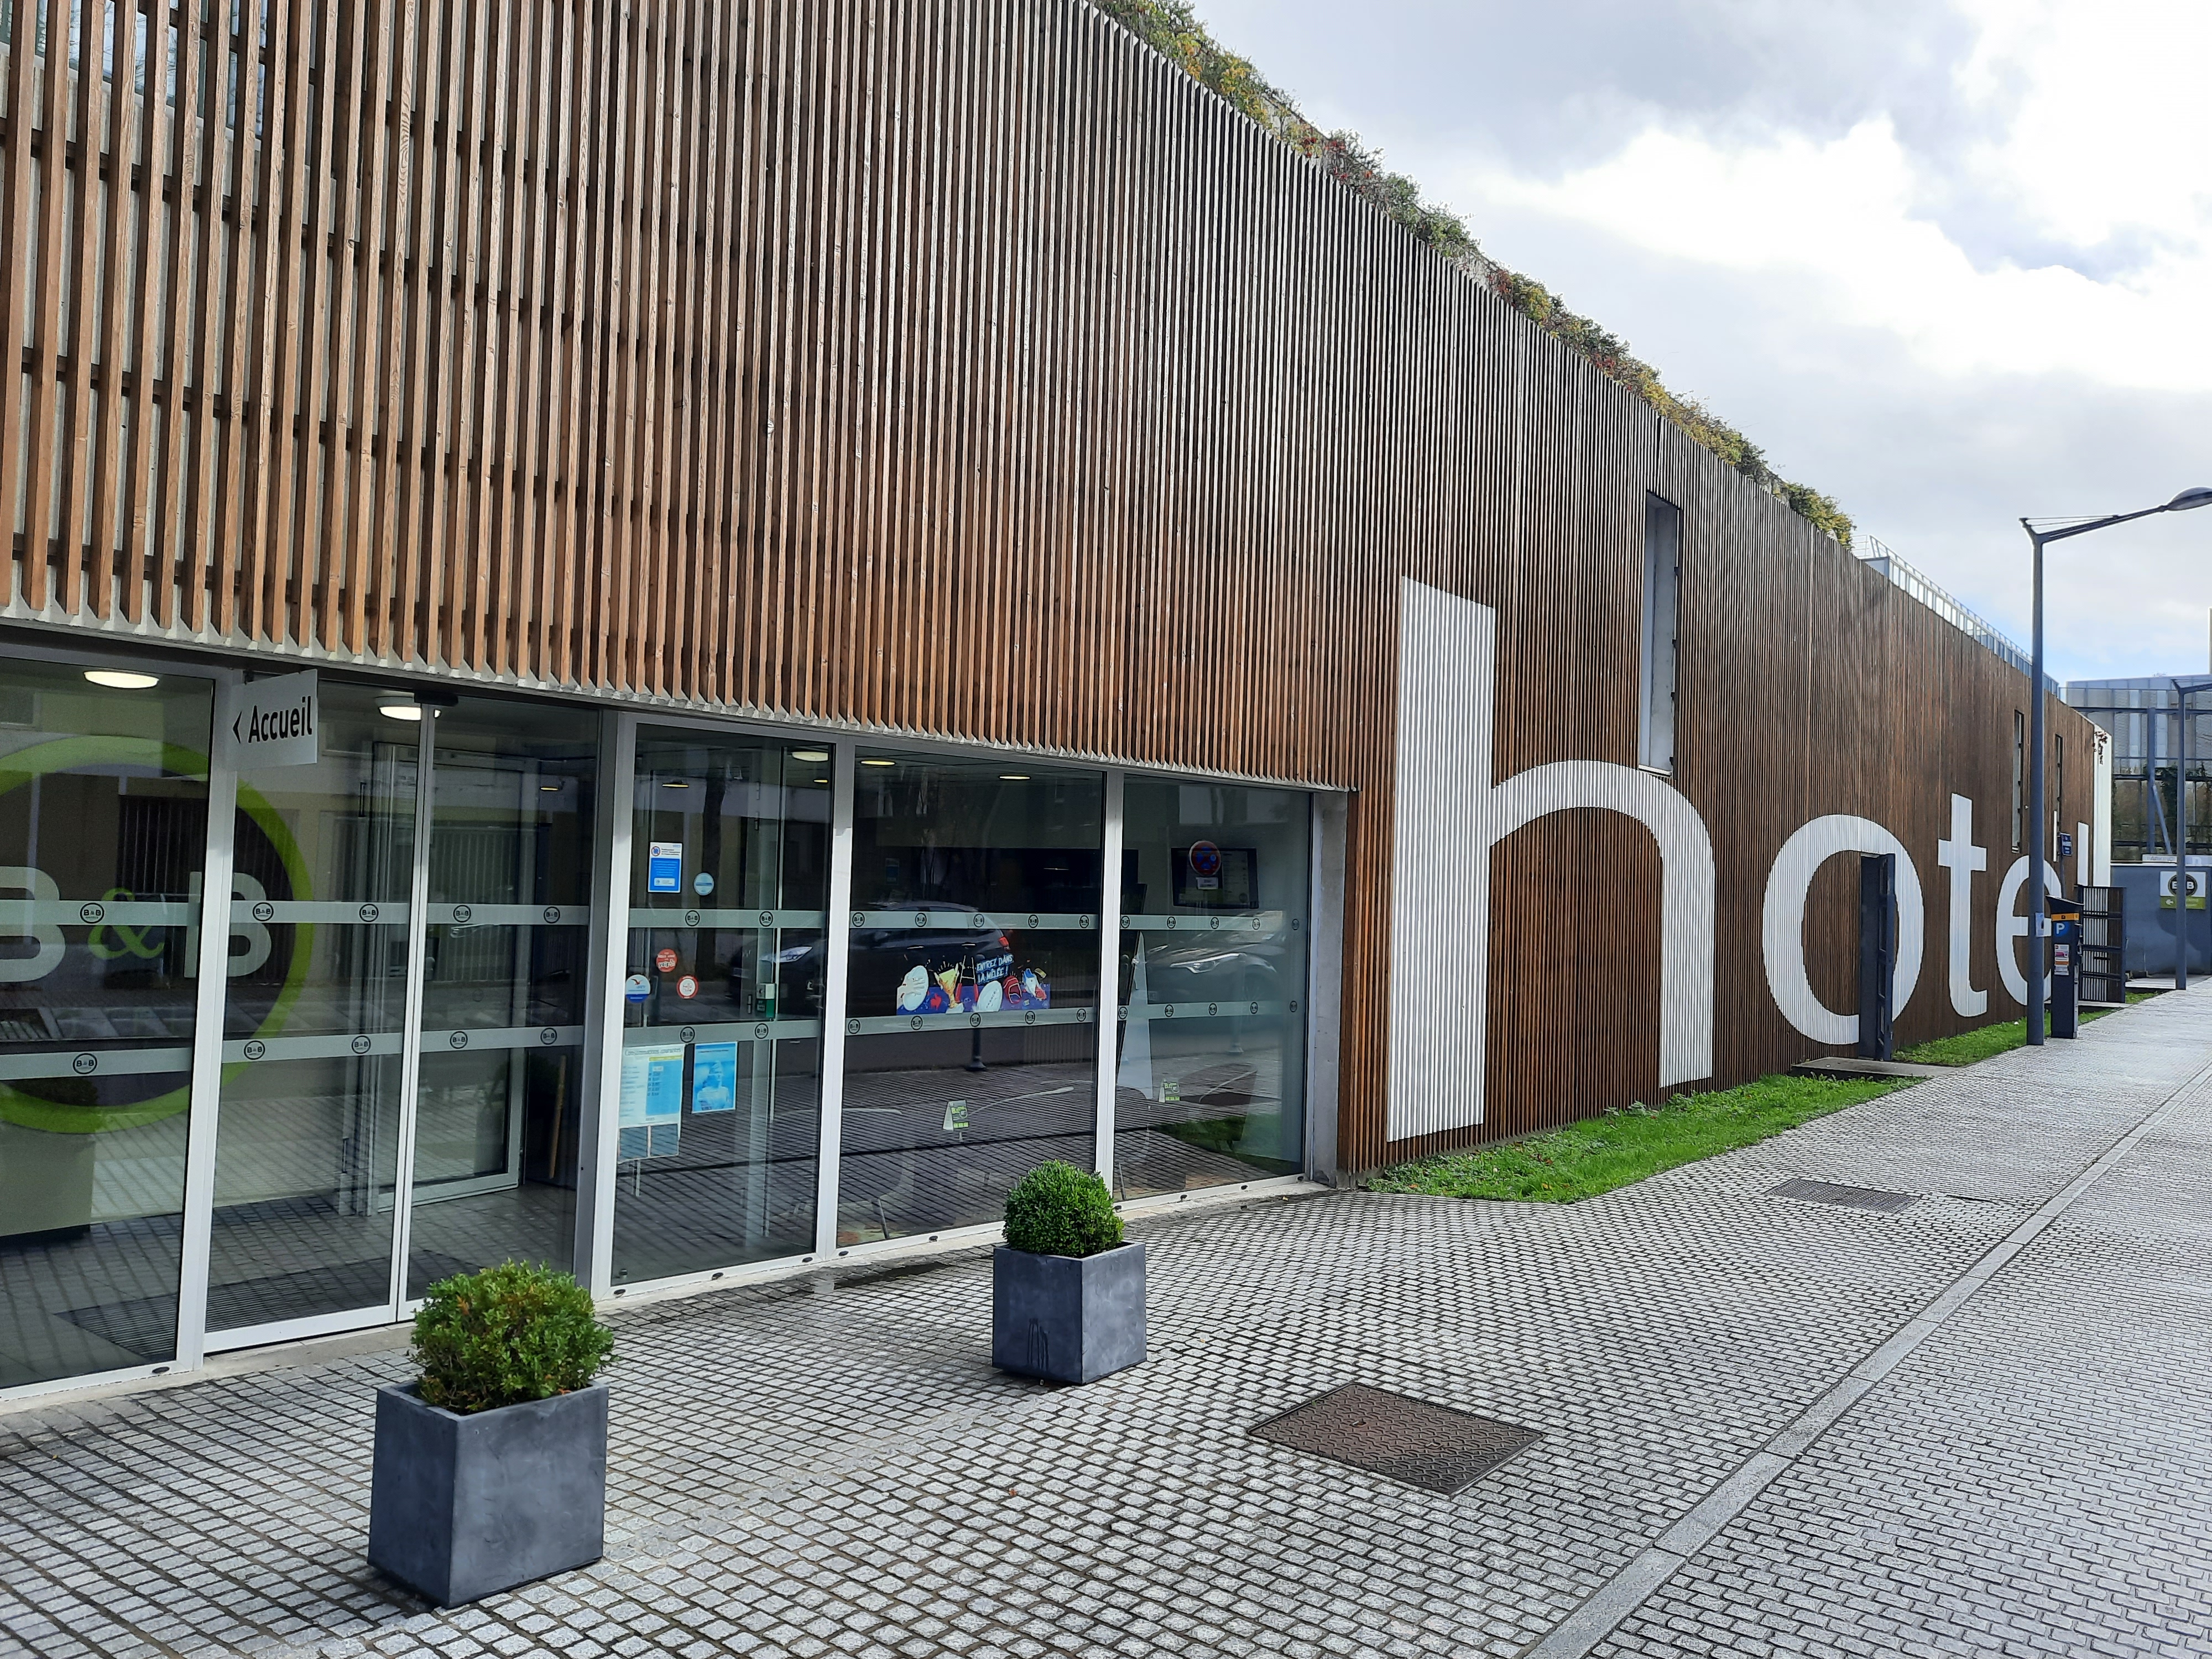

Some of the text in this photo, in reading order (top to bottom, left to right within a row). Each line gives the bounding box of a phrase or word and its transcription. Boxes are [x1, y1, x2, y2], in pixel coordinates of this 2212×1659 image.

[248, 695, 312, 743] Accueil
[2171, 881, 2195, 889] BB
[2056, 922, 2065, 935] P
[977, 954, 1013, 971] ENTREZ DANS
